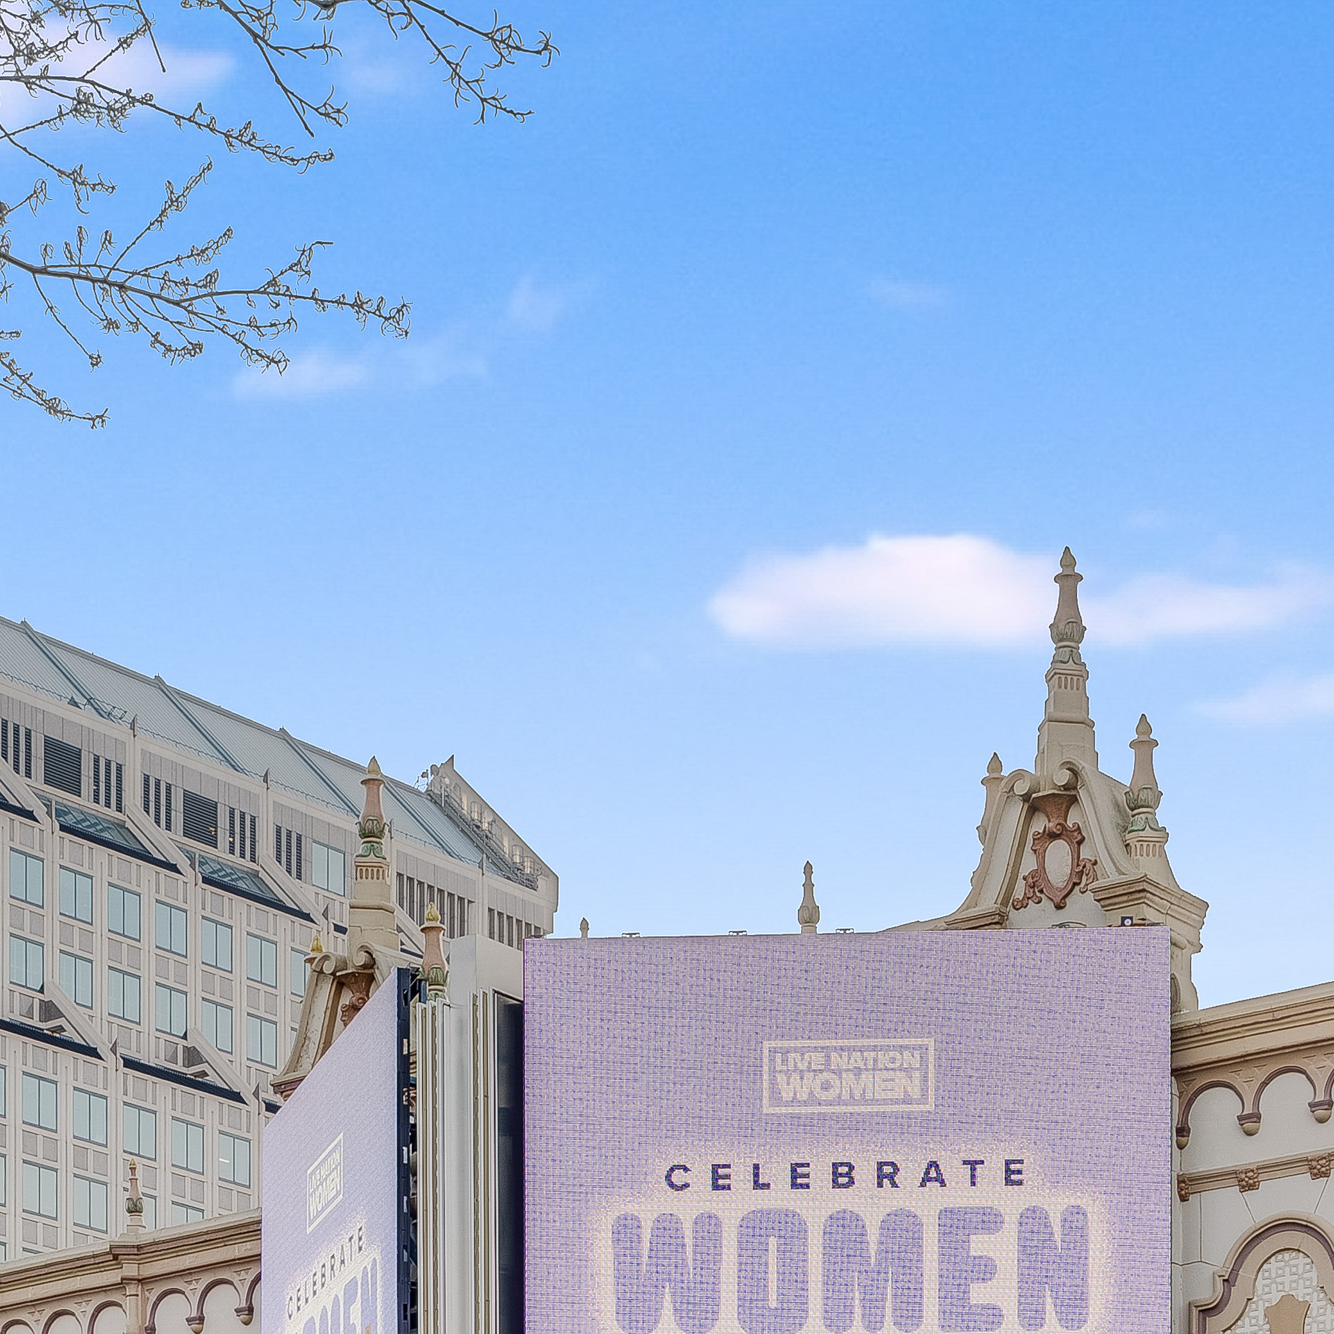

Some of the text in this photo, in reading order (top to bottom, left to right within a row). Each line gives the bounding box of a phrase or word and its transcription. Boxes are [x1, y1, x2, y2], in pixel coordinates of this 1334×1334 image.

[775, 1050, 920, 1070] LIVE NATION
[777, 1070, 921, 1101] WOMEN
[664, 1158, 1026, 1192] CELEBRATE
[286, 1225, 365, 1320] CELEBRATE
